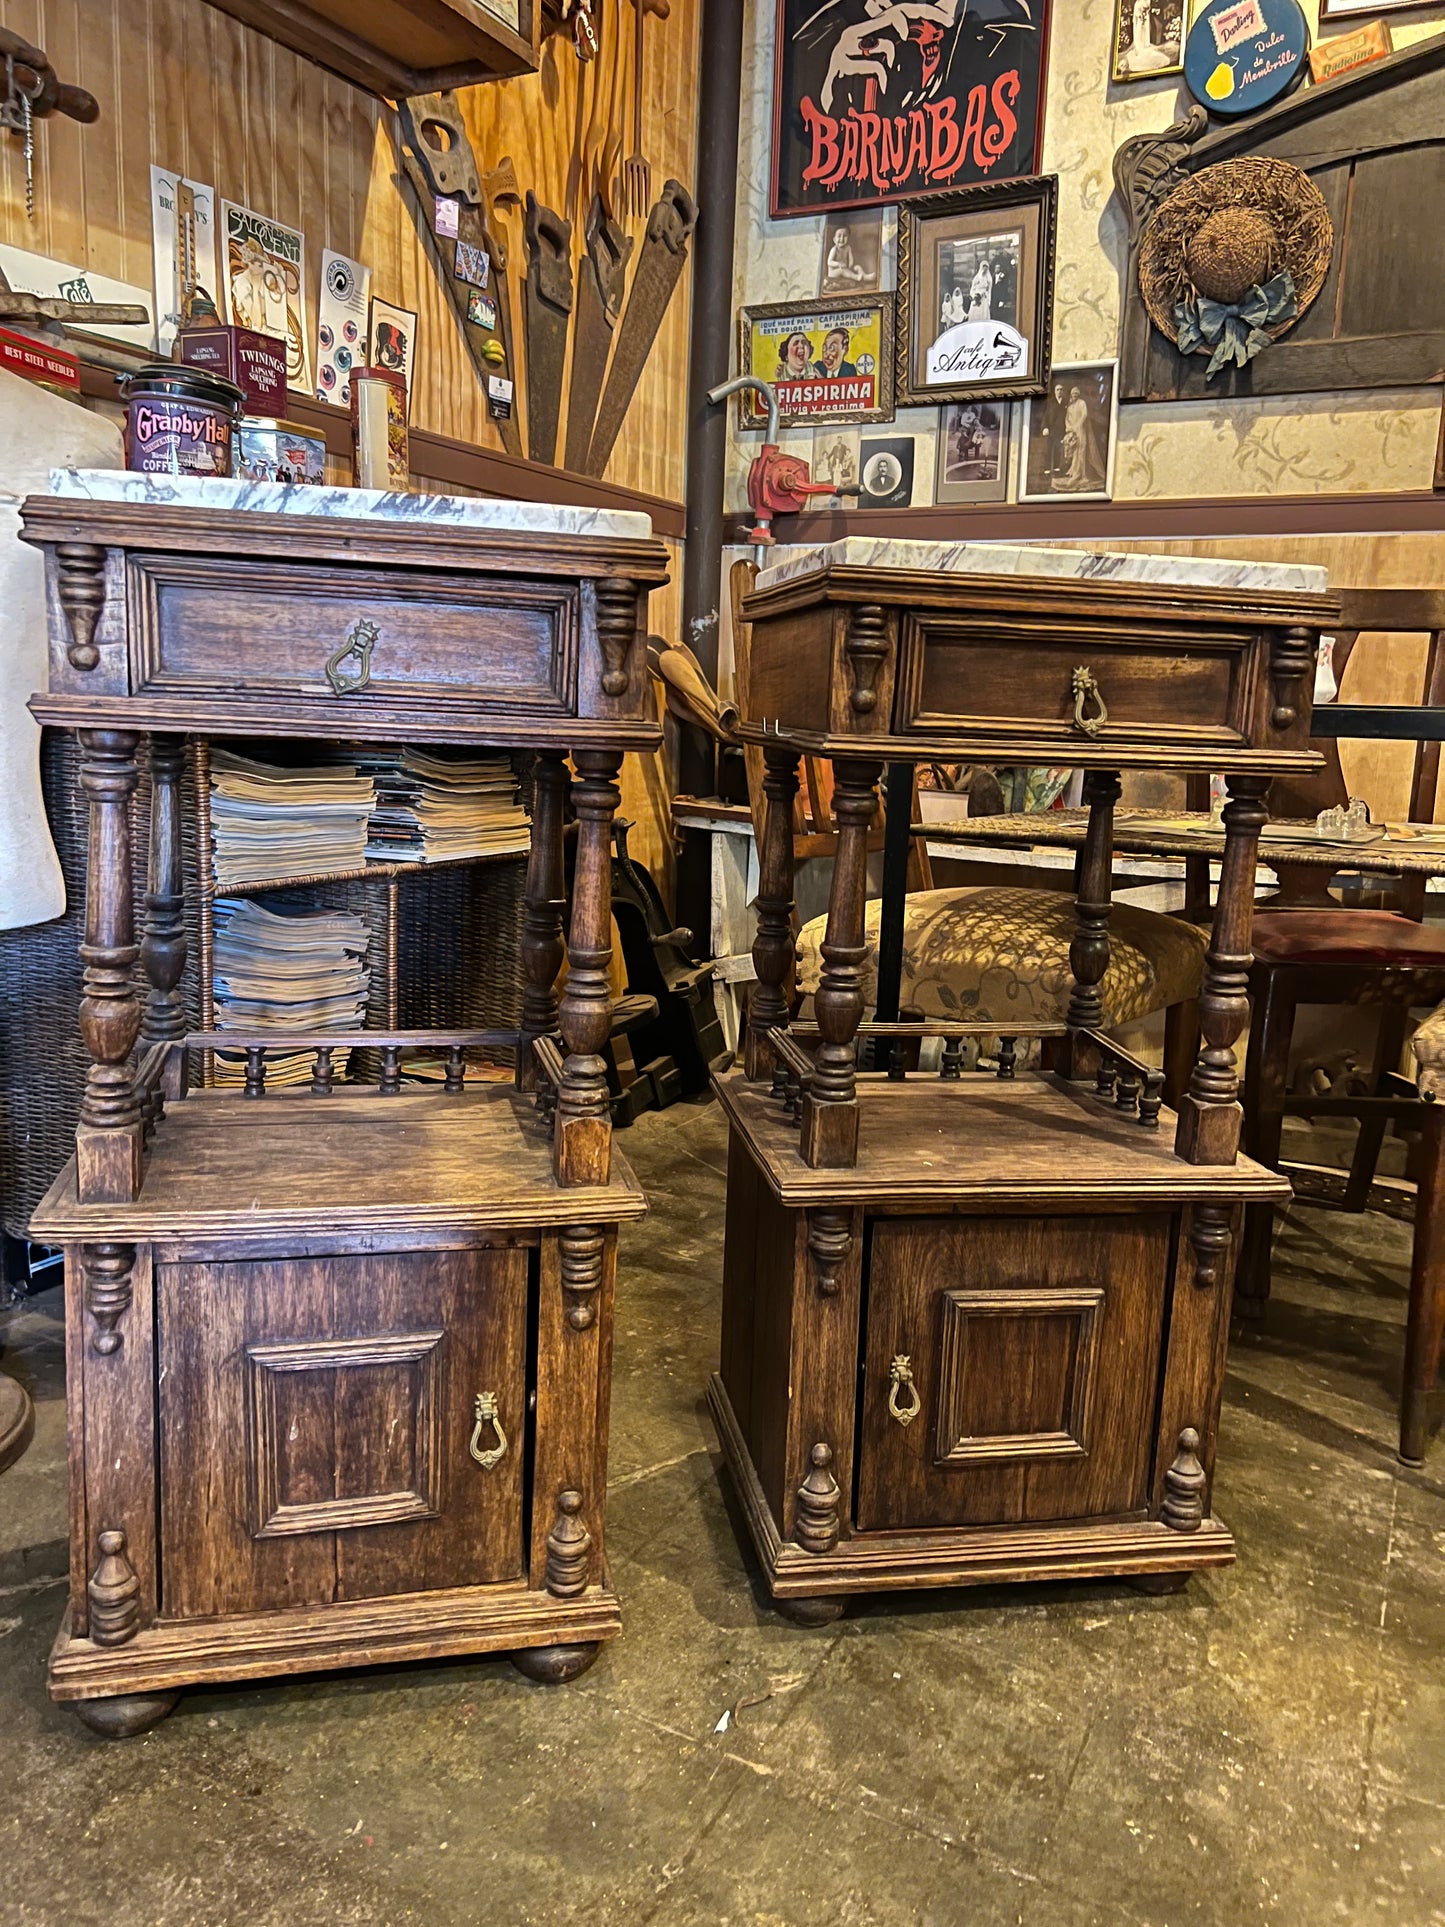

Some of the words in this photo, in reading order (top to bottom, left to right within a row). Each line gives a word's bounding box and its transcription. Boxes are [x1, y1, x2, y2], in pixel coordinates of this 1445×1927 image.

[1221, 10, 1255, 43] Darling
[1255, 31, 1285, 53] Dulce
[1239, 50, 1298, 89] Membrillo
[1253, 57, 1264, 68] de
[1324, 47, 1374, 77] Radiolina
[800, 69, 1021, 195] BARNABAS
[763, 327, 778, 335] ESTE
[797, 317, 814, 325] PARA
[963, 338, 984, 357] café
[4, 345, 23, 360] BEST
[24, 352, 45, 368] STEEL
[47, 360, 75, 378] NEEDLES
[239, 349, 286, 374] TWININGS
[251, 364, 276, 379] LAPSANG
[258, 382, 269, 393] TEA
[821, 401, 865, 412] reanima
[137, 407, 205, 442] Granby
[205, 416, 229, 444] Hall
